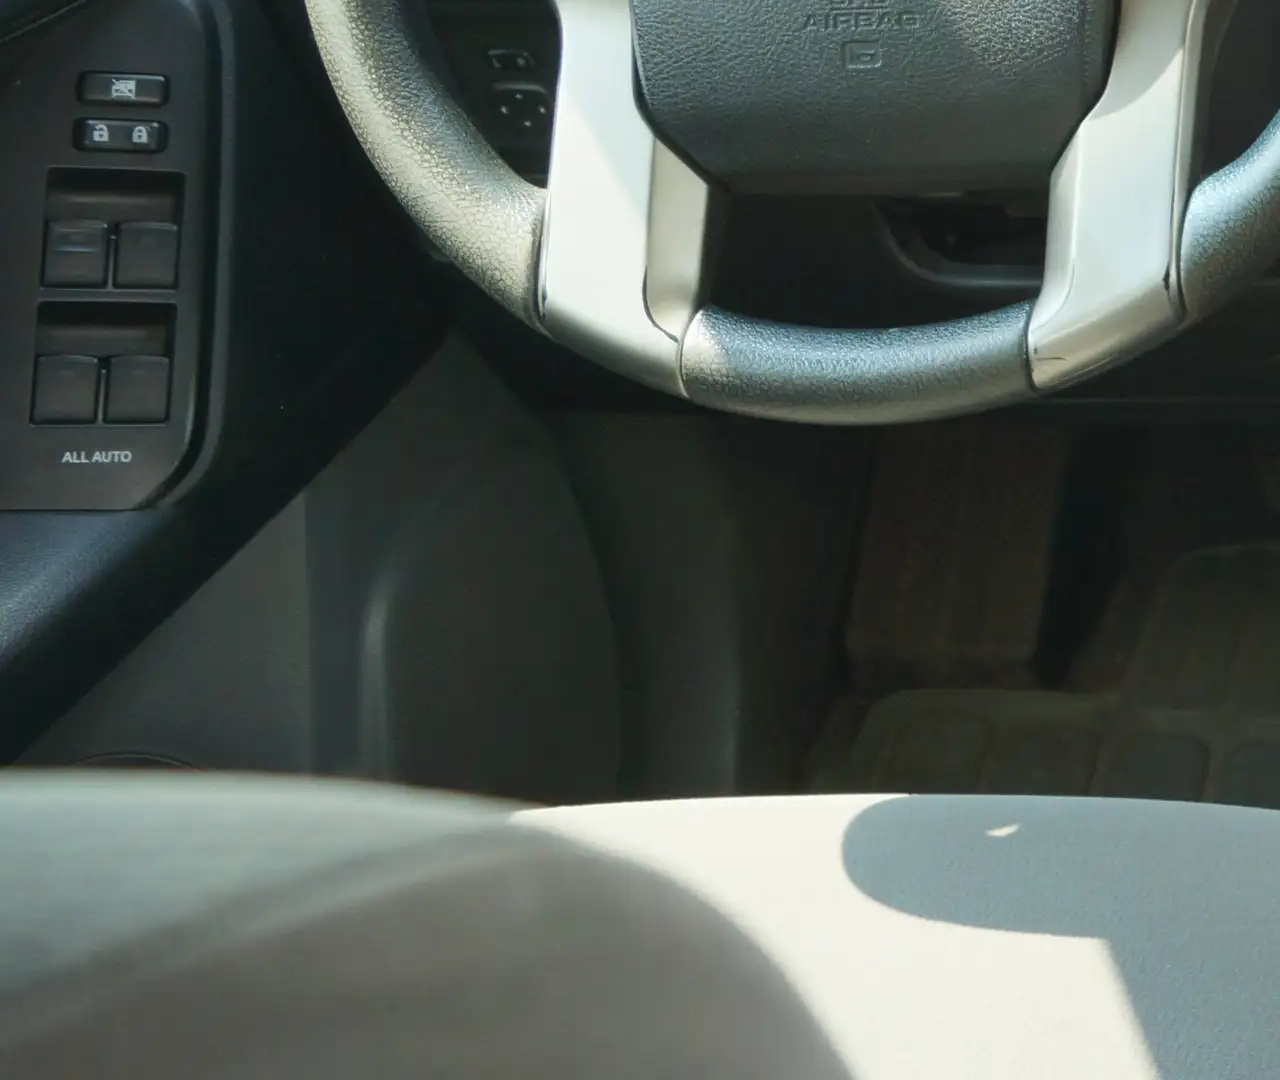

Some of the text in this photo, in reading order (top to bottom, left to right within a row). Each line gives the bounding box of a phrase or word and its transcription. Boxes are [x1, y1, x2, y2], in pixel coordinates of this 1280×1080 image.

[804, 11, 920, 30] AIRBAG
[61, 450, 133, 463] ALL AUTO
